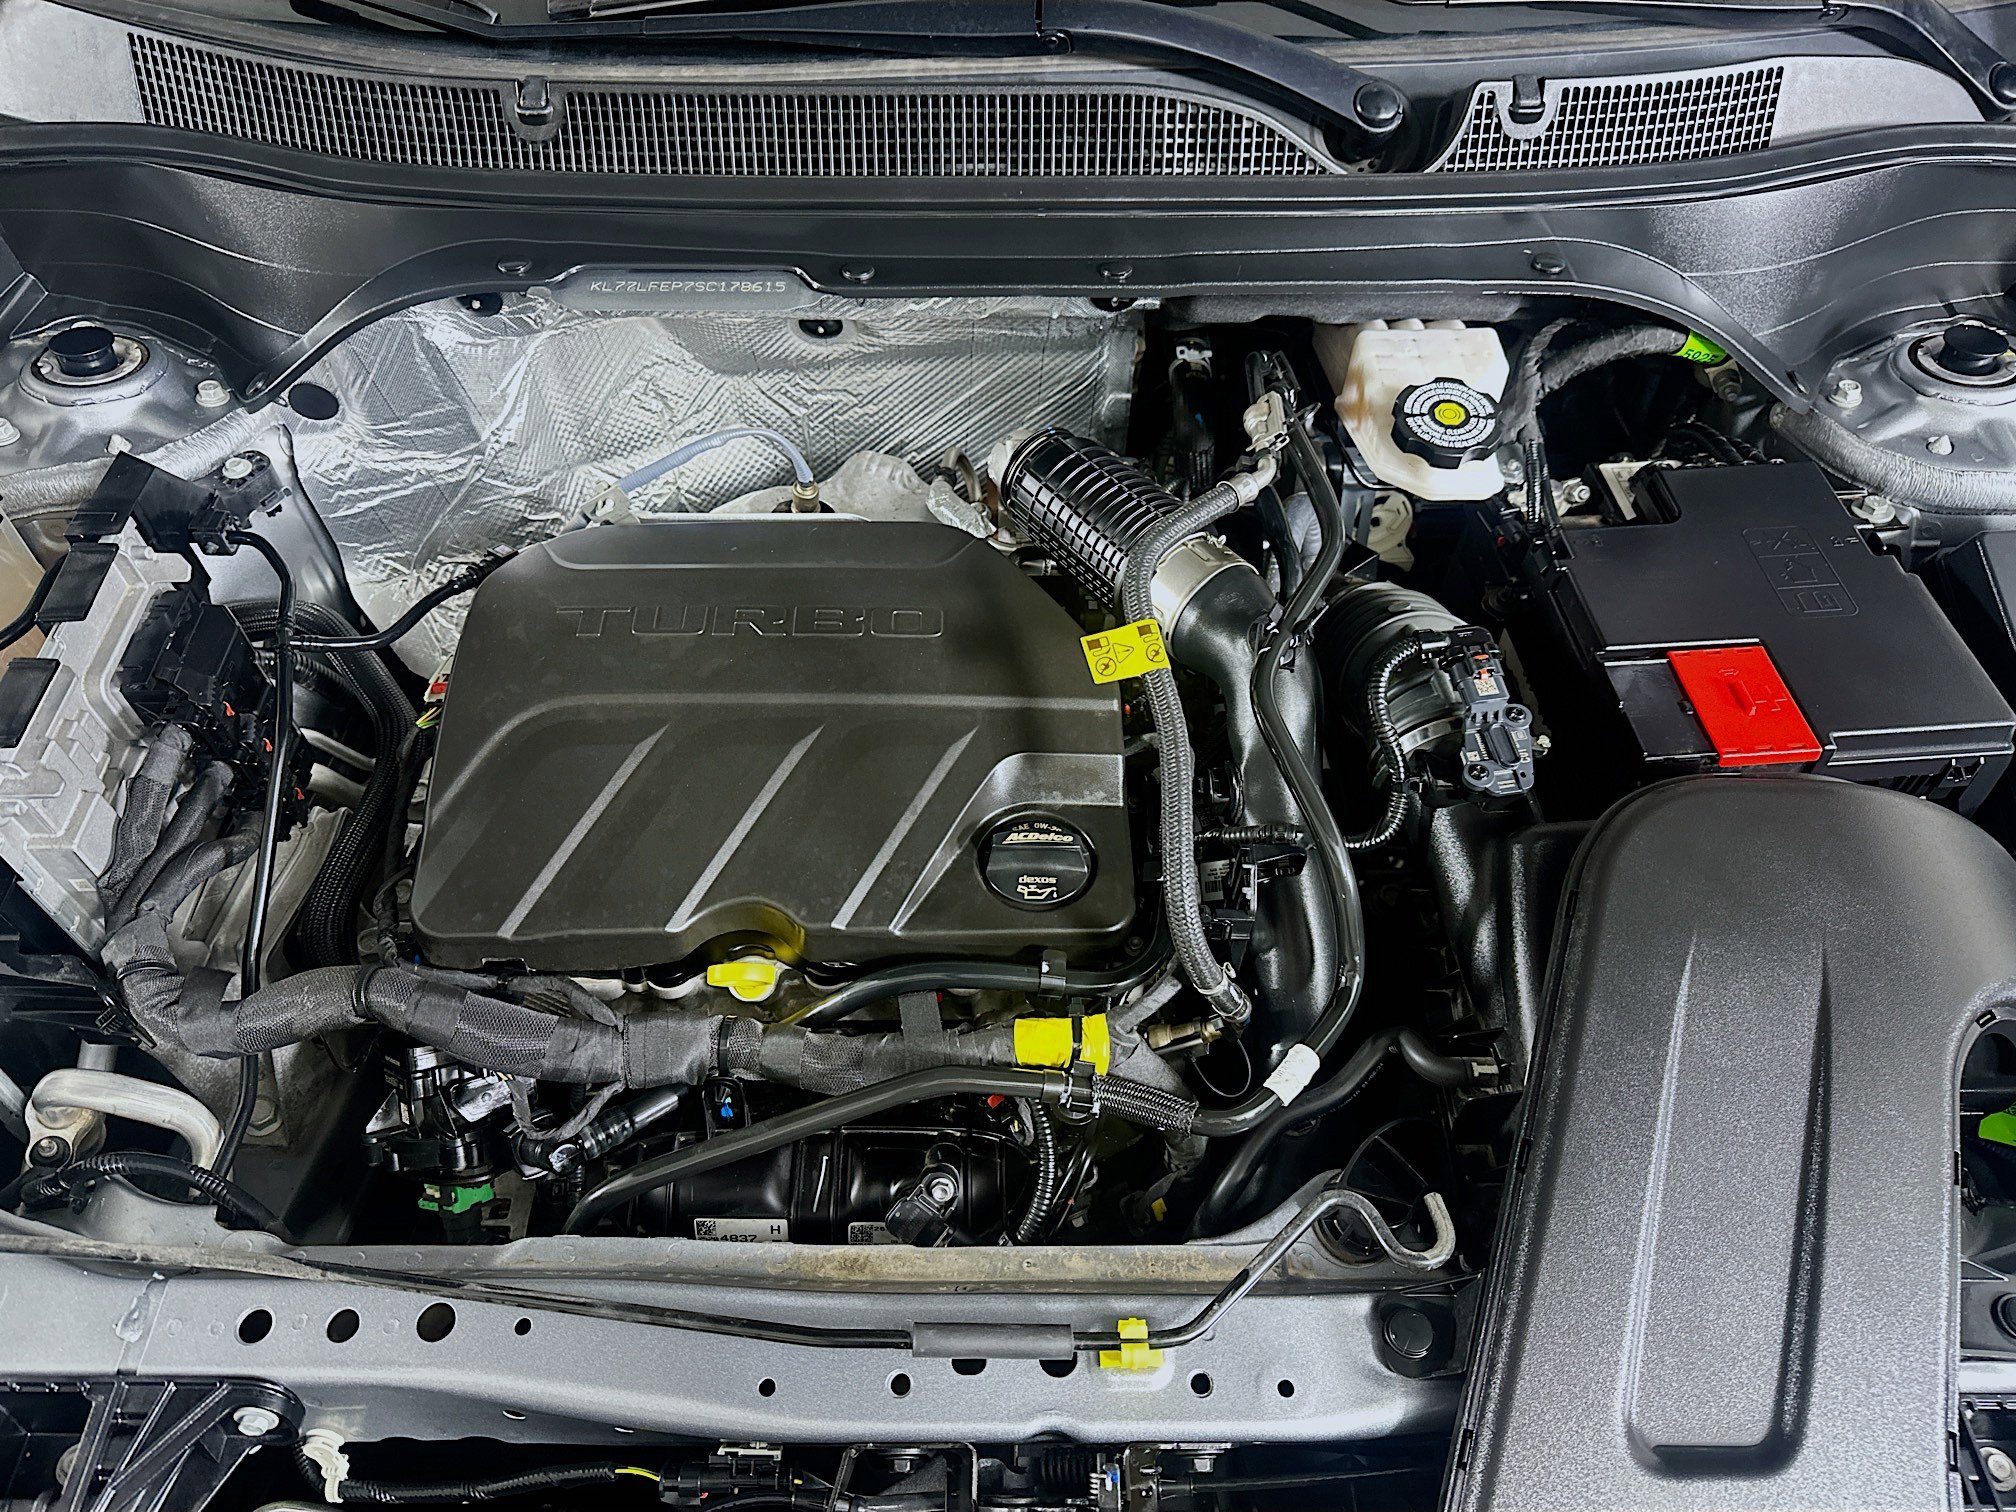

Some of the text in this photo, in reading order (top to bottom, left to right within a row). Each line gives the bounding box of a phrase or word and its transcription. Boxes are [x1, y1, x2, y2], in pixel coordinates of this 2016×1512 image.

[589, 281, 786, 293] KL77LFEP7SC178615
[556, 605, 944, 638] TURBO
[1002, 832, 1074, 845] ACDelco
[1018, 874, 1058, 884] dexos
[770, 1224, 782, 1235] H
